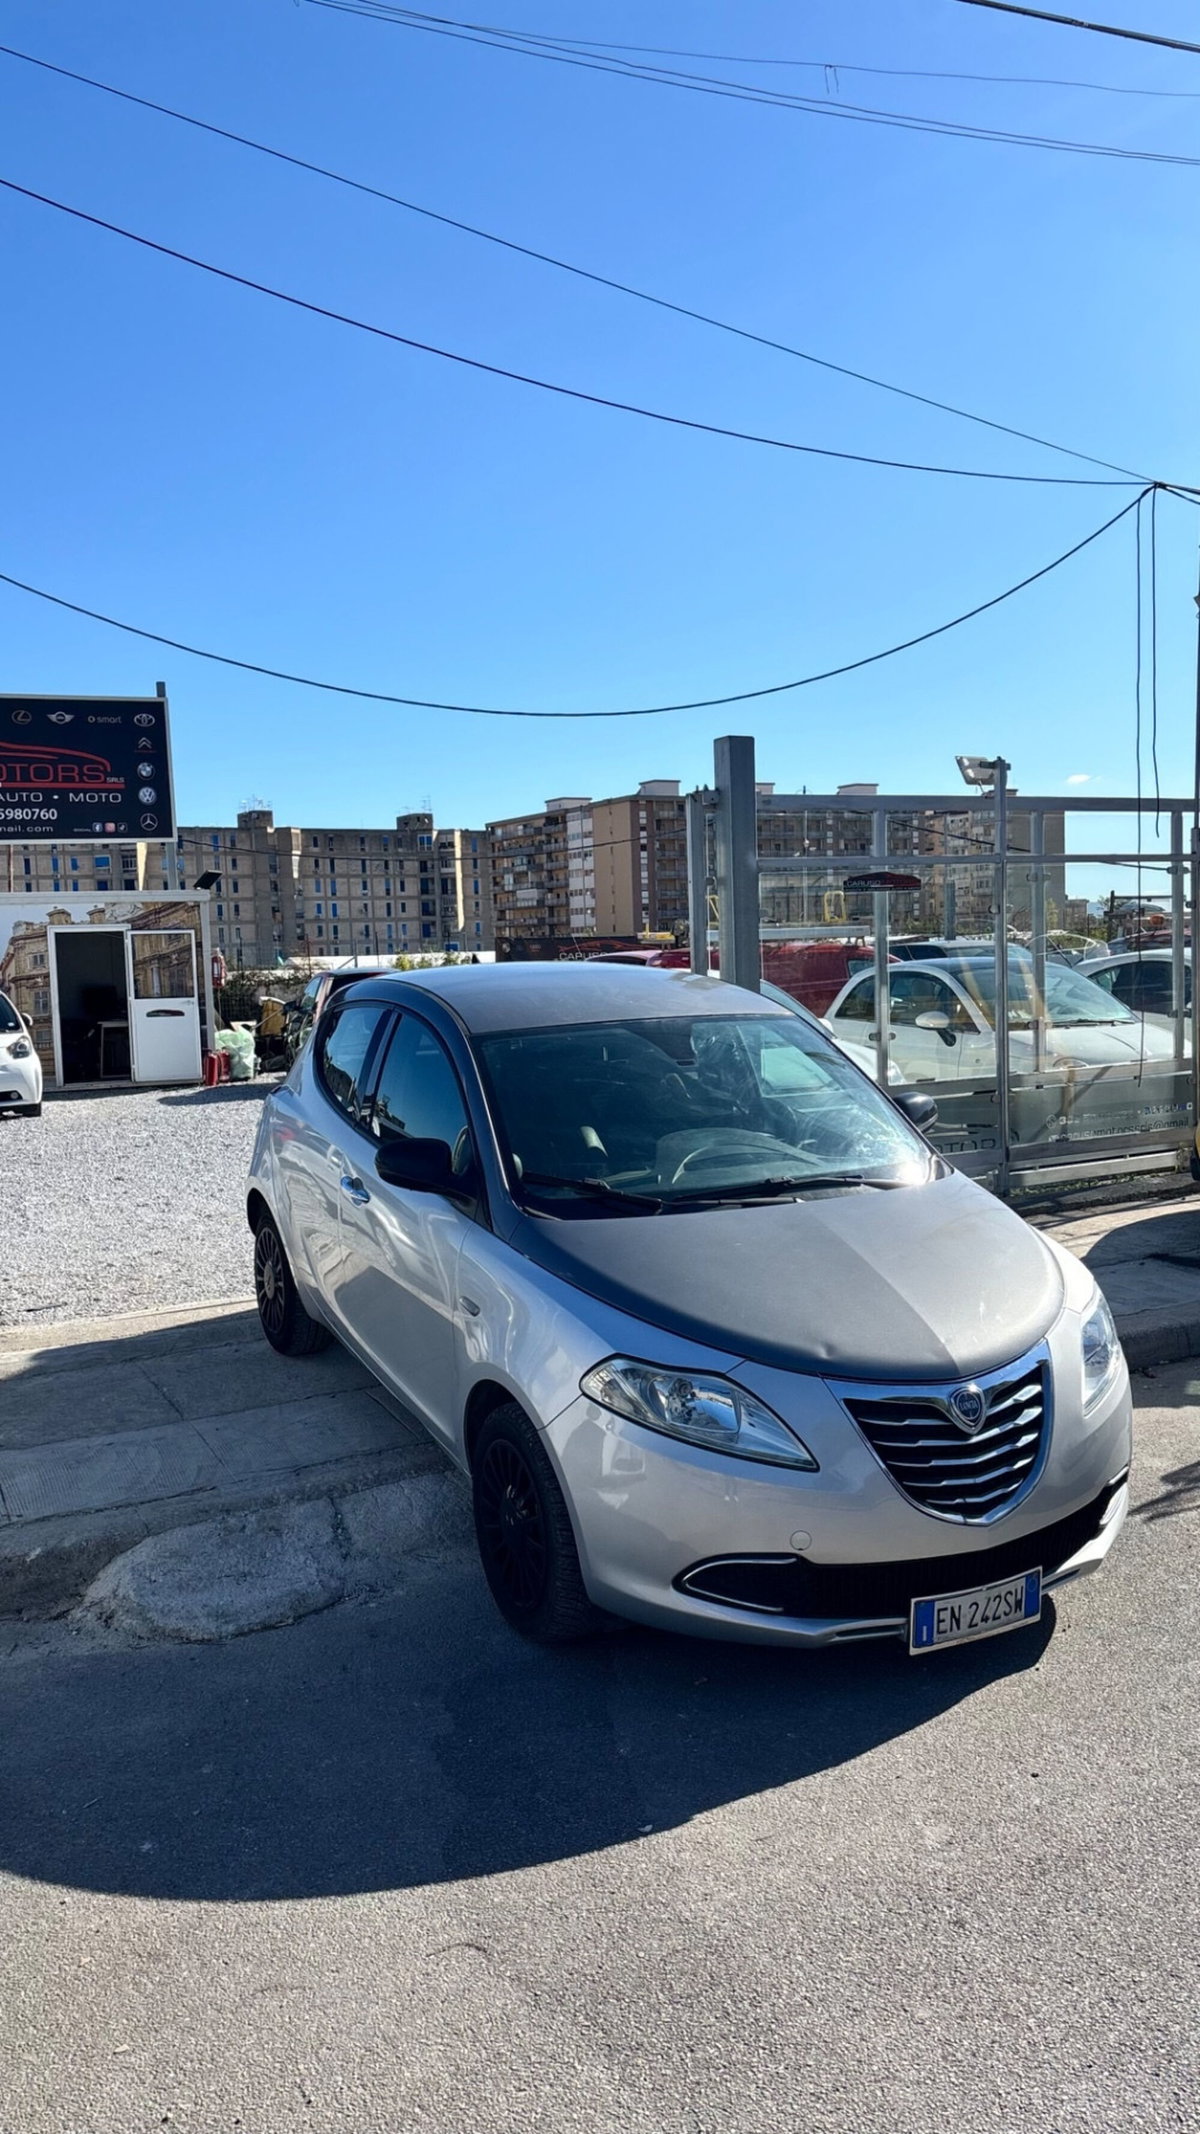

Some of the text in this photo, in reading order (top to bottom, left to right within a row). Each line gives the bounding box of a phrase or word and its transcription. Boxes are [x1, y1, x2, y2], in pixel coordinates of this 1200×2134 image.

[97, 716, 122, 724] smart
[0, 763, 105, 783] TORS
[69, 792, 122, 803] MOTO
[936, 1585, 1024, 1635] EN 242SW
